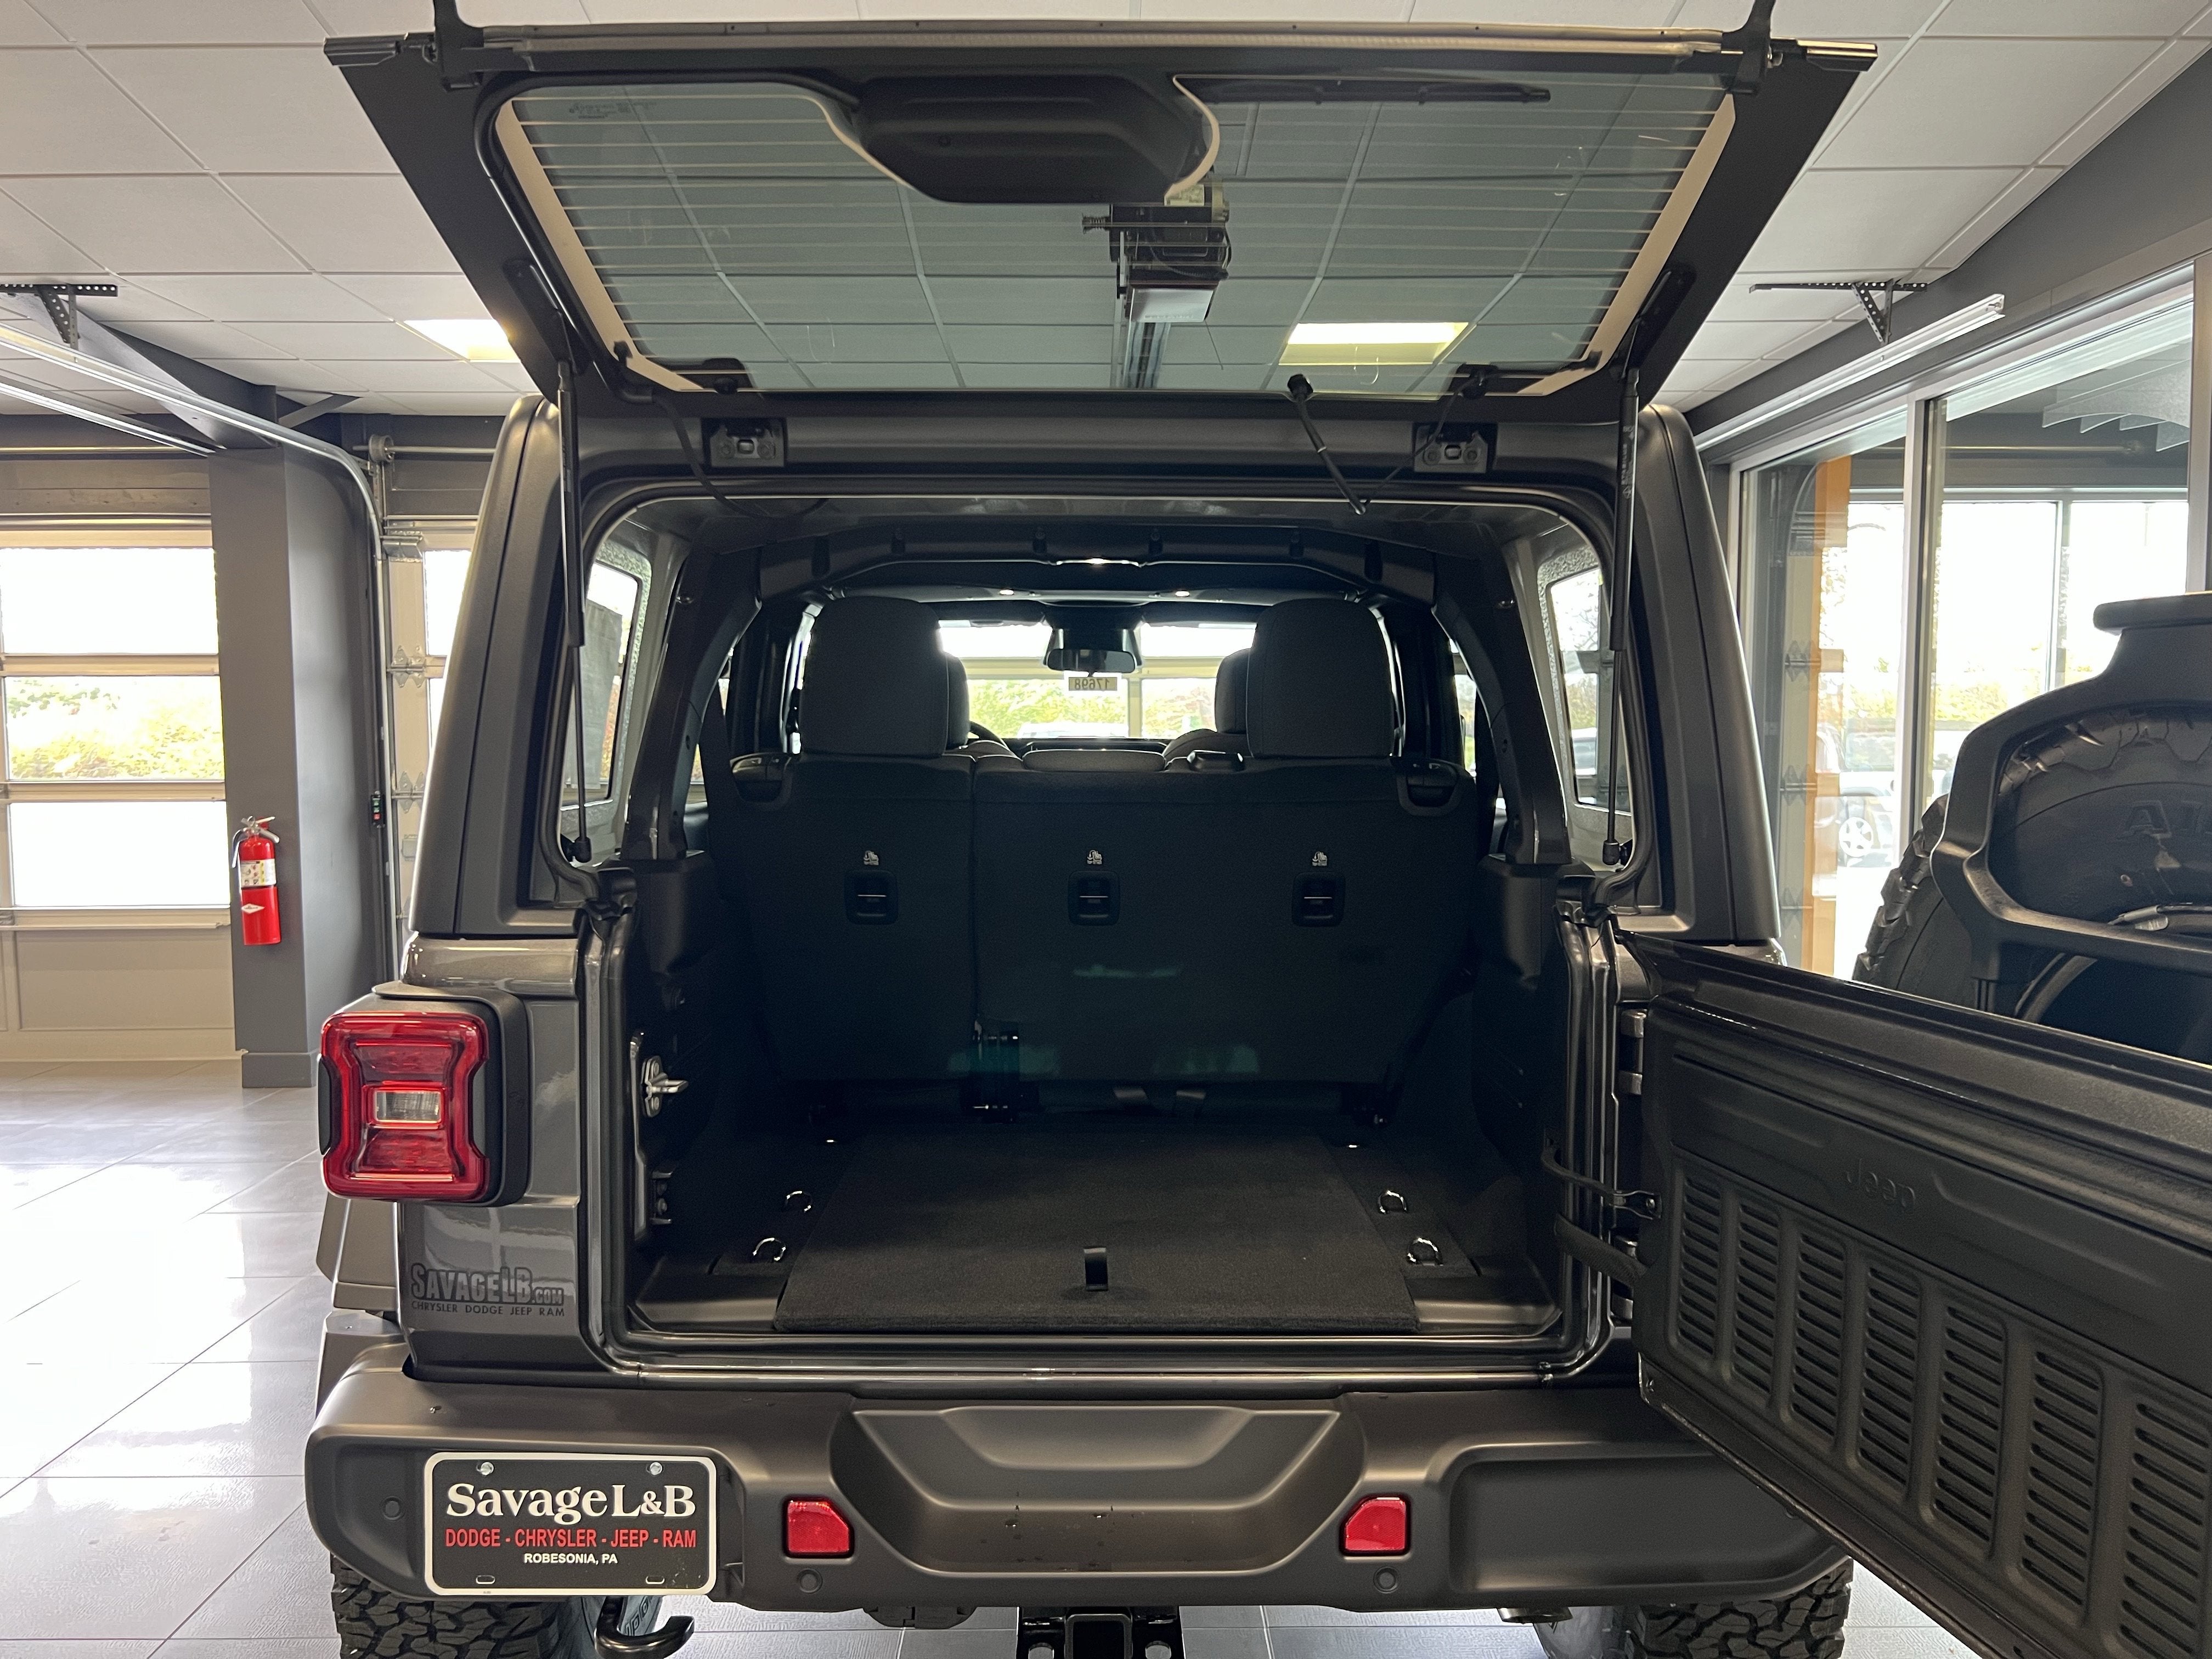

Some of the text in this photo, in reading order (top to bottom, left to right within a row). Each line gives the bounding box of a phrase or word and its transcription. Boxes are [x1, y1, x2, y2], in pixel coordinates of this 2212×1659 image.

[411, 1301, 565, 1317] CHRYSLER DODGE JEEP RAM
[444, 1527, 501, 1548] DODGE
[514, 1527, 597, 1548] CHRYSLER
[610, 1528, 650, 1548] JEEP
[662, 1528, 697, 1548] RAM
[523, 1553, 618, 1565] ROBESONIA, PA
